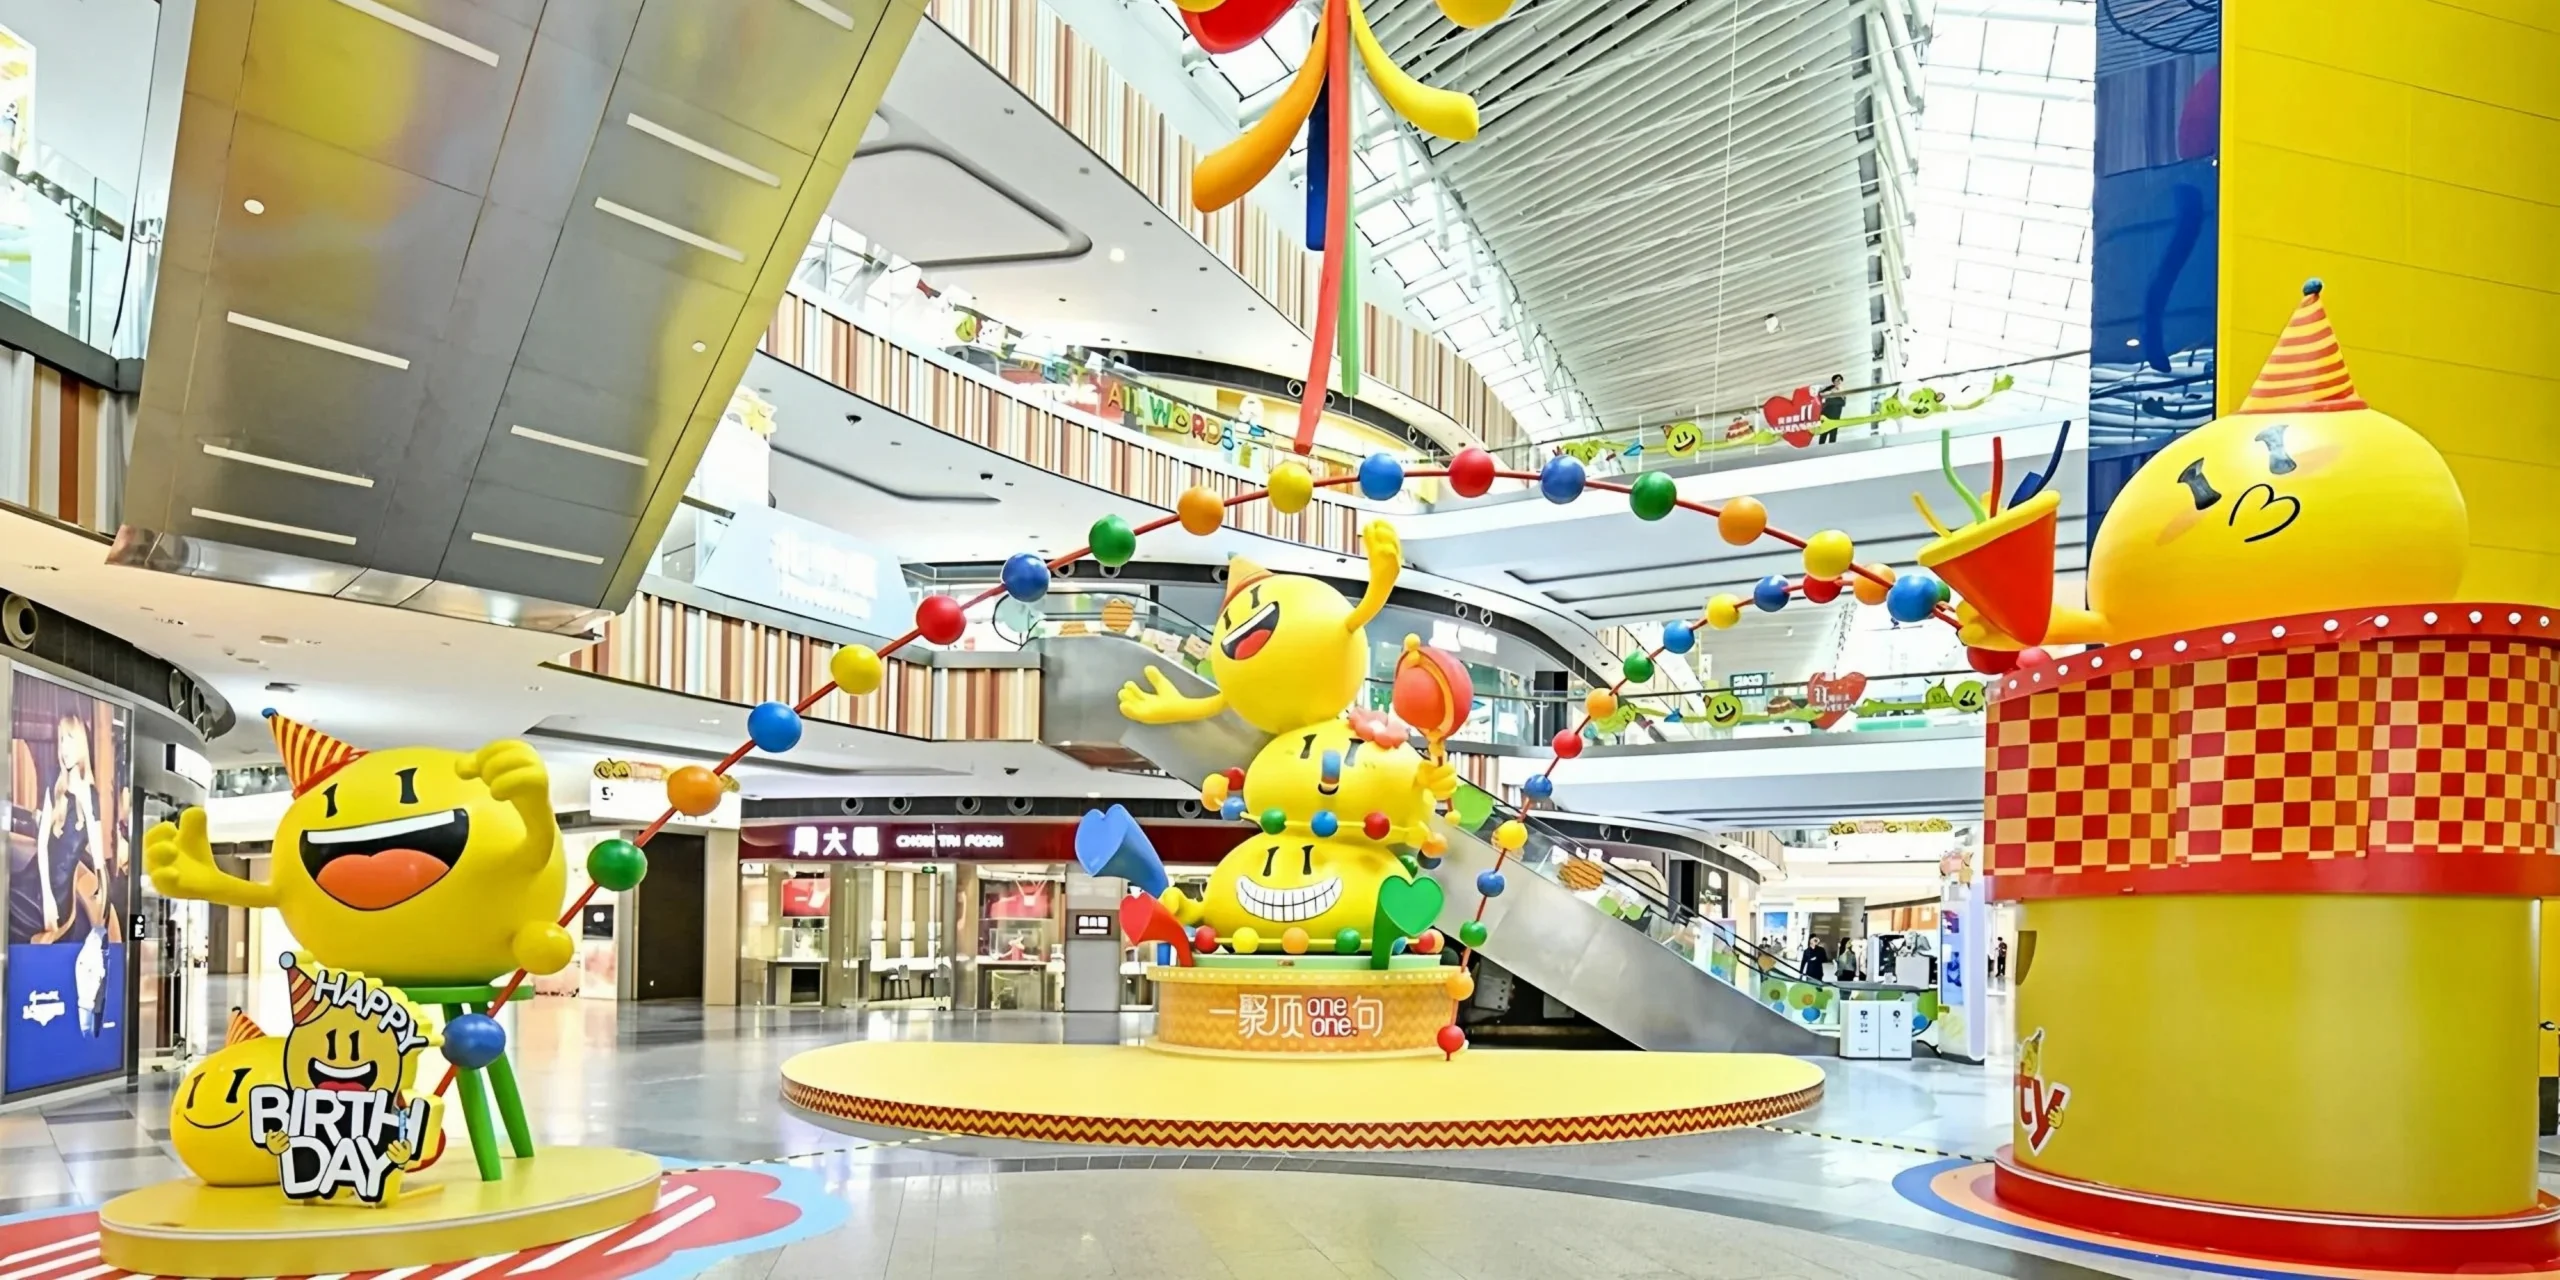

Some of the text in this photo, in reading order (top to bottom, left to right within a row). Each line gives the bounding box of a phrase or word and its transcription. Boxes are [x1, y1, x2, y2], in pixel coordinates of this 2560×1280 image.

[1149, 394, 1235, 451] WORDS
[312, 969, 430, 1055] HAPPY
[1208, 994, 1305, 1039] 一聚顶
[1306, 998, 1348, 1018] one
[1352, 994, 1384, 1038] 句
[250, 1087, 425, 1157] BIRTH
[280, 1135, 392, 1199] DAY
